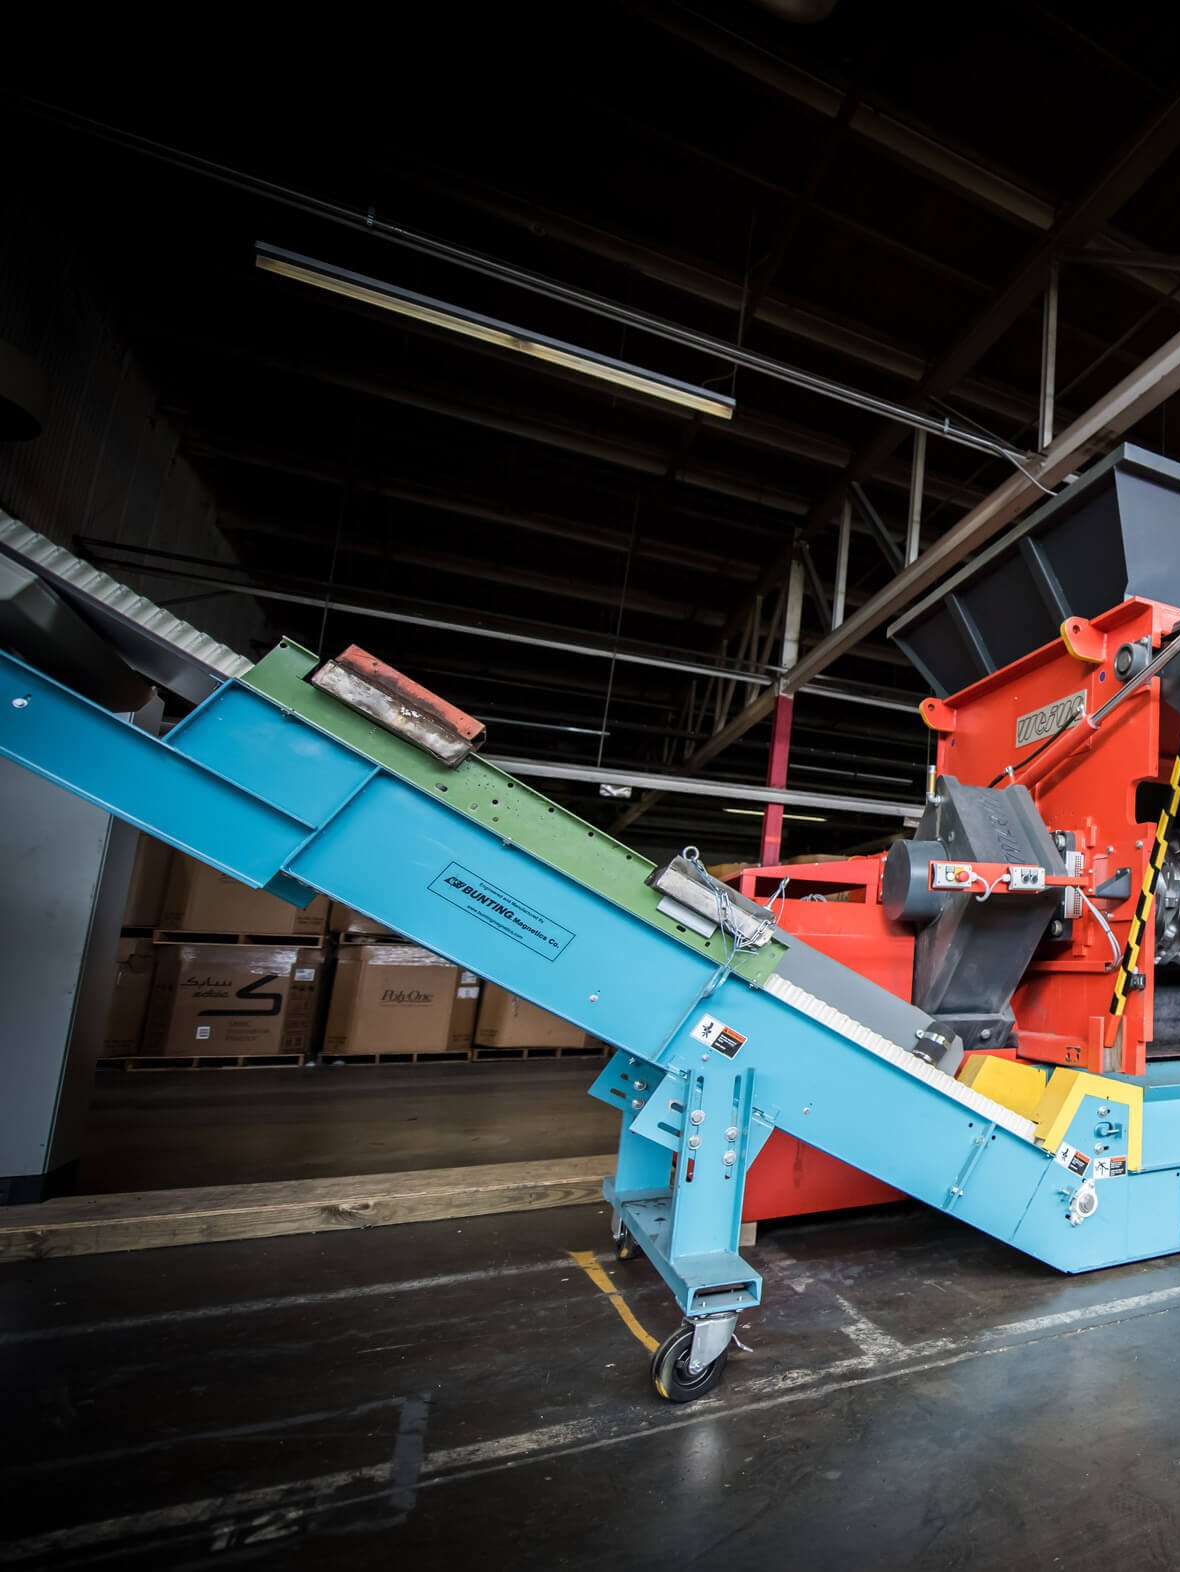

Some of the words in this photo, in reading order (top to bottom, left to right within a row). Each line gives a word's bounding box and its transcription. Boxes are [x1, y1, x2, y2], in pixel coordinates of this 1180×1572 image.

[462, 885, 515, 920] BUNTING
[512, 917, 548, 941] Magnetics
[548, 938, 560, 949] Co.
